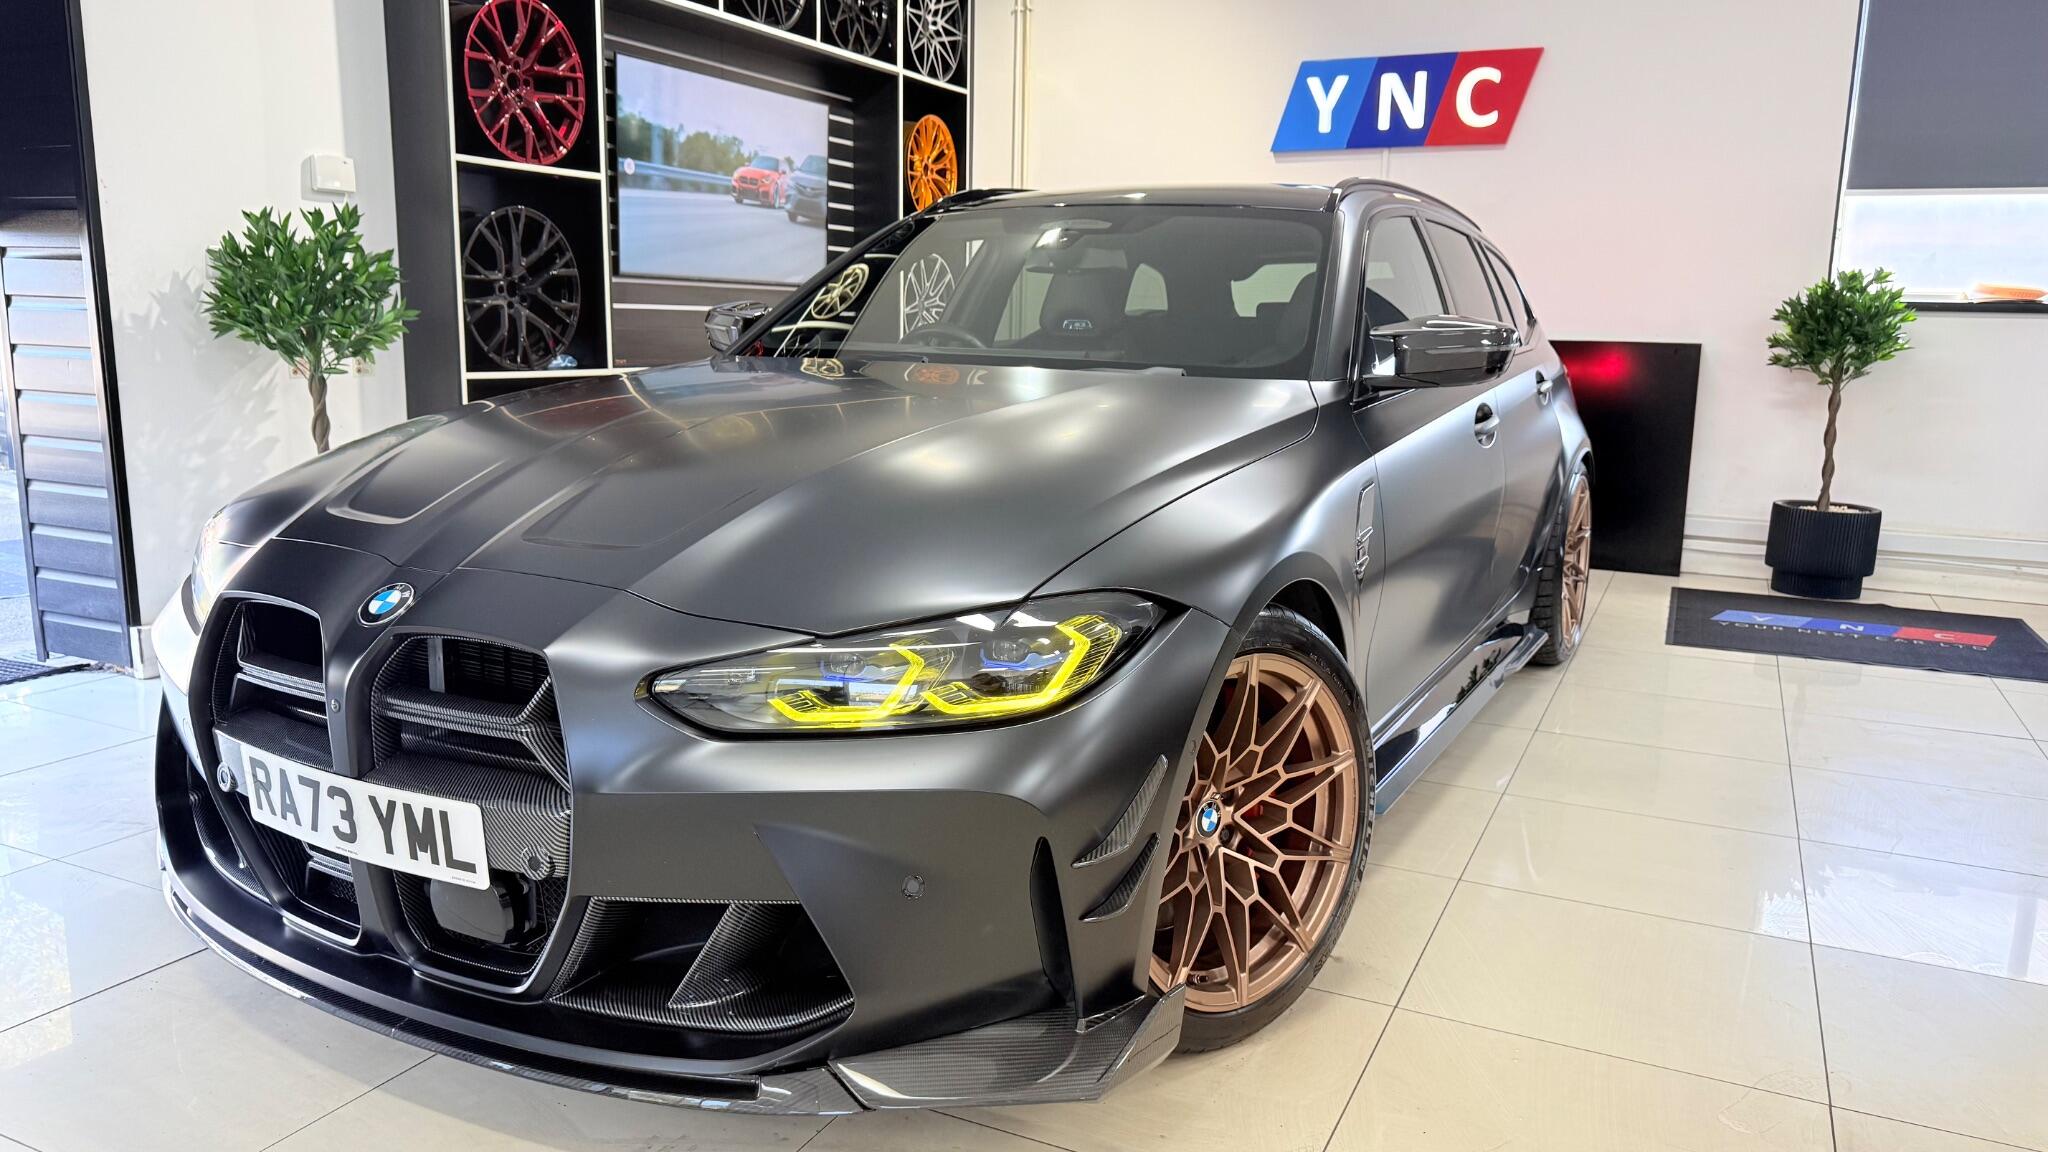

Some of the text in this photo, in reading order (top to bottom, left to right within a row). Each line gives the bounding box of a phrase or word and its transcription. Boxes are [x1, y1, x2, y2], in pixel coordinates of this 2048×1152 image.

[1306, 66, 1502, 134] YNC
[1719, 620, 1988, 651] YOUR NEXT CAR LTD
[249, 756, 477, 874] RA73 YML
